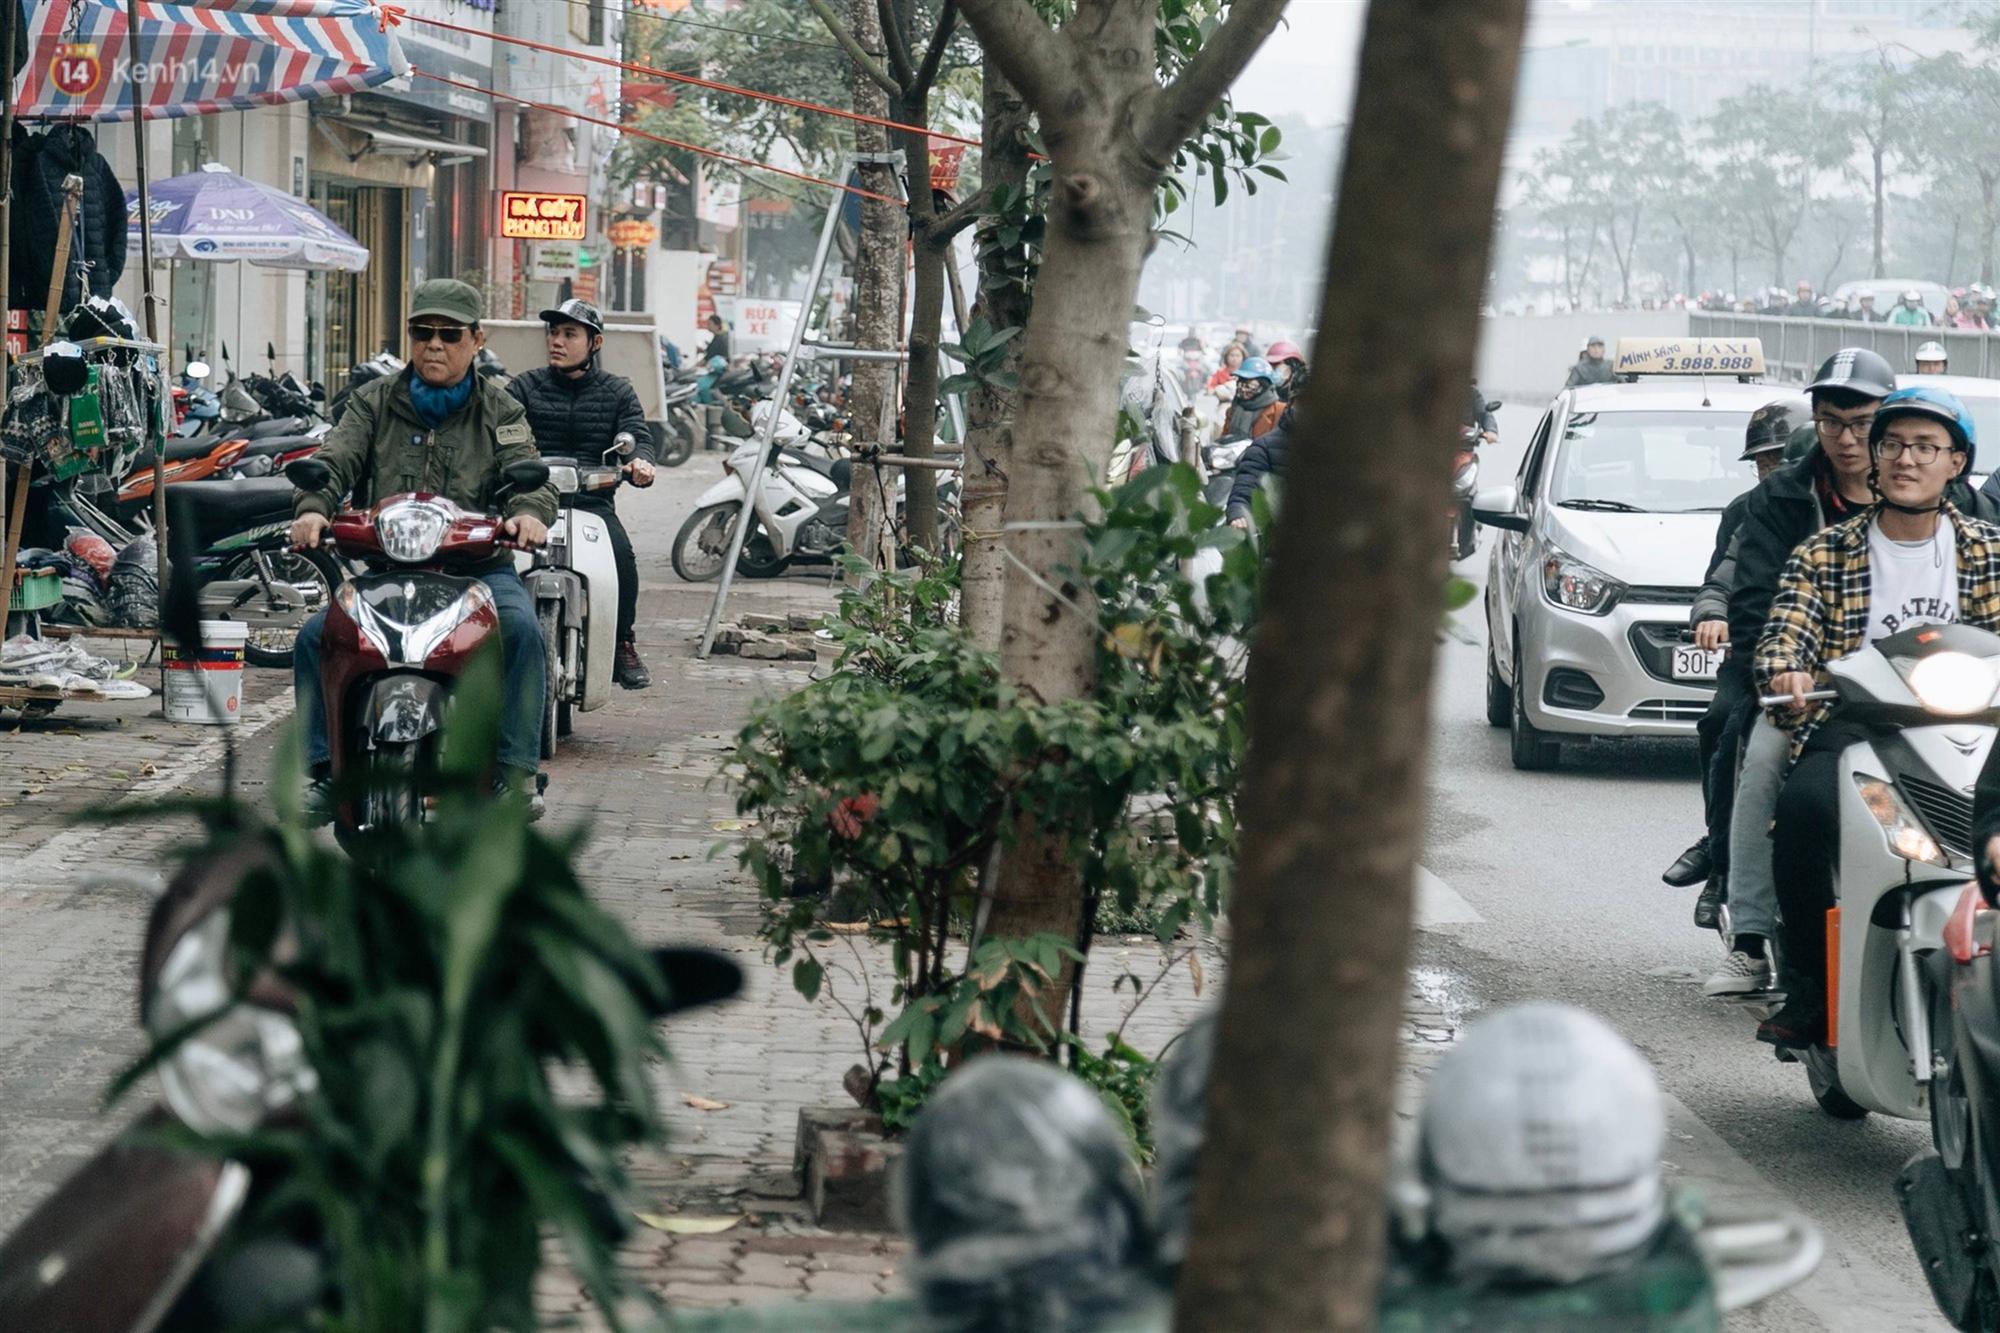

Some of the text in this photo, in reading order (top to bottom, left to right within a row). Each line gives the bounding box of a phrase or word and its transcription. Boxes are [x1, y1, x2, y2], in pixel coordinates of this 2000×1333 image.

[208, 207, 255, 221] DND
[748, 215, 785, 230] AFE
[1693, 343, 1748, 354] TAXI
[1663, 356, 1753, 370] 3.988.988
[1677, 652, 1713, 674] 30F
